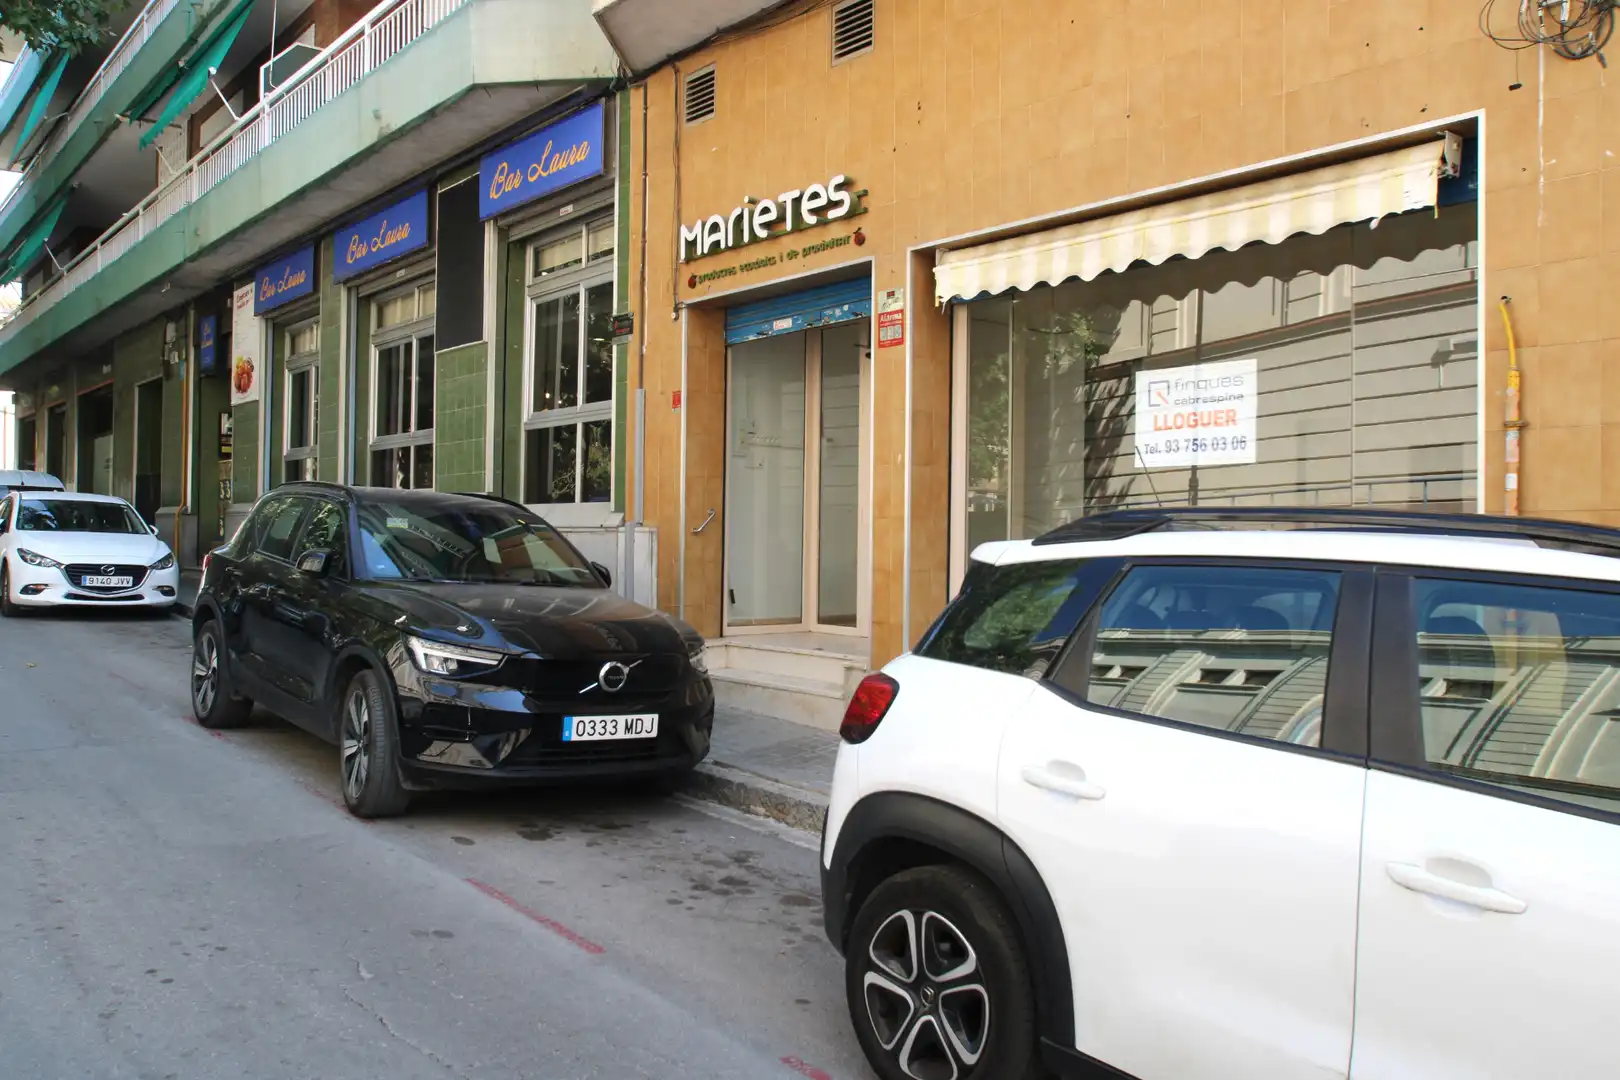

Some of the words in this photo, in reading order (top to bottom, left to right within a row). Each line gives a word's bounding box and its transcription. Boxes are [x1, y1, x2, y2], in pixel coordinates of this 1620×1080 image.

[489, 161, 523, 199] Bar
[528, 139, 591, 182] Laura
[346, 234, 369, 264] Bar
[370, 219, 411, 253] Laura
[259, 276, 276, 301] Bar
[276, 265, 307, 293] Laura
[1174, 374, 1244, 391] finques
[1152, 408, 1238, 432] LLOGUER
[1144, 442, 1162, 455] Tel.
[1164, 439, 1180, 453] 93
[1183, 437, 1208, 453] 756
[1211, 436, 1227, 451] 03
[1231, 435, 1247, 450] 06
[88, 577, 112, 585] 9140
[113, 577, 131, 585] JVV
[575, 719, 618, 737] 0333
[623, 717, 655, 735] MDJ
